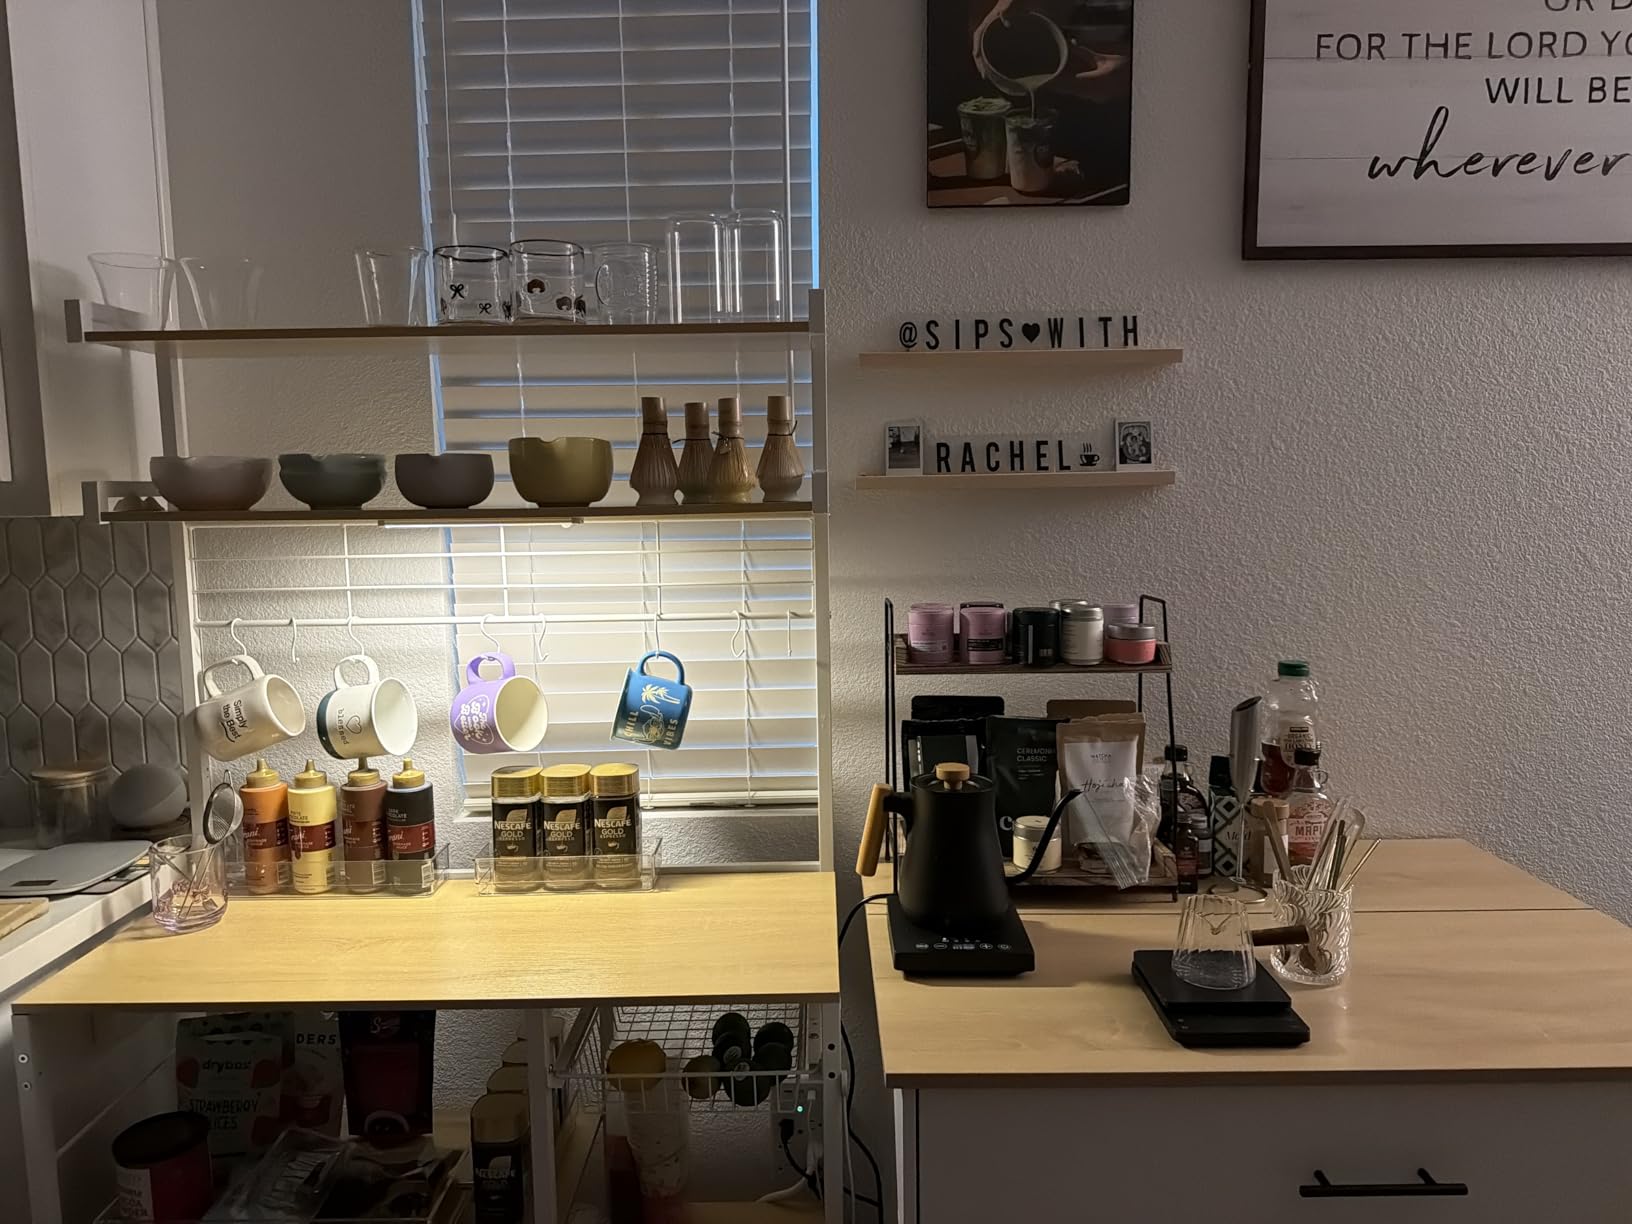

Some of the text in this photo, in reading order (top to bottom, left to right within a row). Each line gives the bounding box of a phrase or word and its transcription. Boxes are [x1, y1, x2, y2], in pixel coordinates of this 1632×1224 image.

[1316, 32, 1387, 61] FOR
[1401, 32, 1473, 60] THE
[1487, 31, 1588, 59] LORD
[1485, 75, 1632, 105] WILL BE
[1367, 105, 1632, 181] wherever
[936, 439, 1072, 474] RACHEL
[222, 704, 242, 740] the Best
[233, 698, 249, 729] Simply
[337, 707, 350, 745] blessed
[470, 701, 485, 740] Book
[623, 711, 640, 737] CHILL
[663, 718, 679, 746] VIBES
[1016, 755, 1048, 763] CLASSIC
[500, 830, 524, 838] GOLD
[550, 830, 573, 838] GOLD
[601, 828, 625, 836] GOLD
[1295, 825, 1322, 836] MAPL
